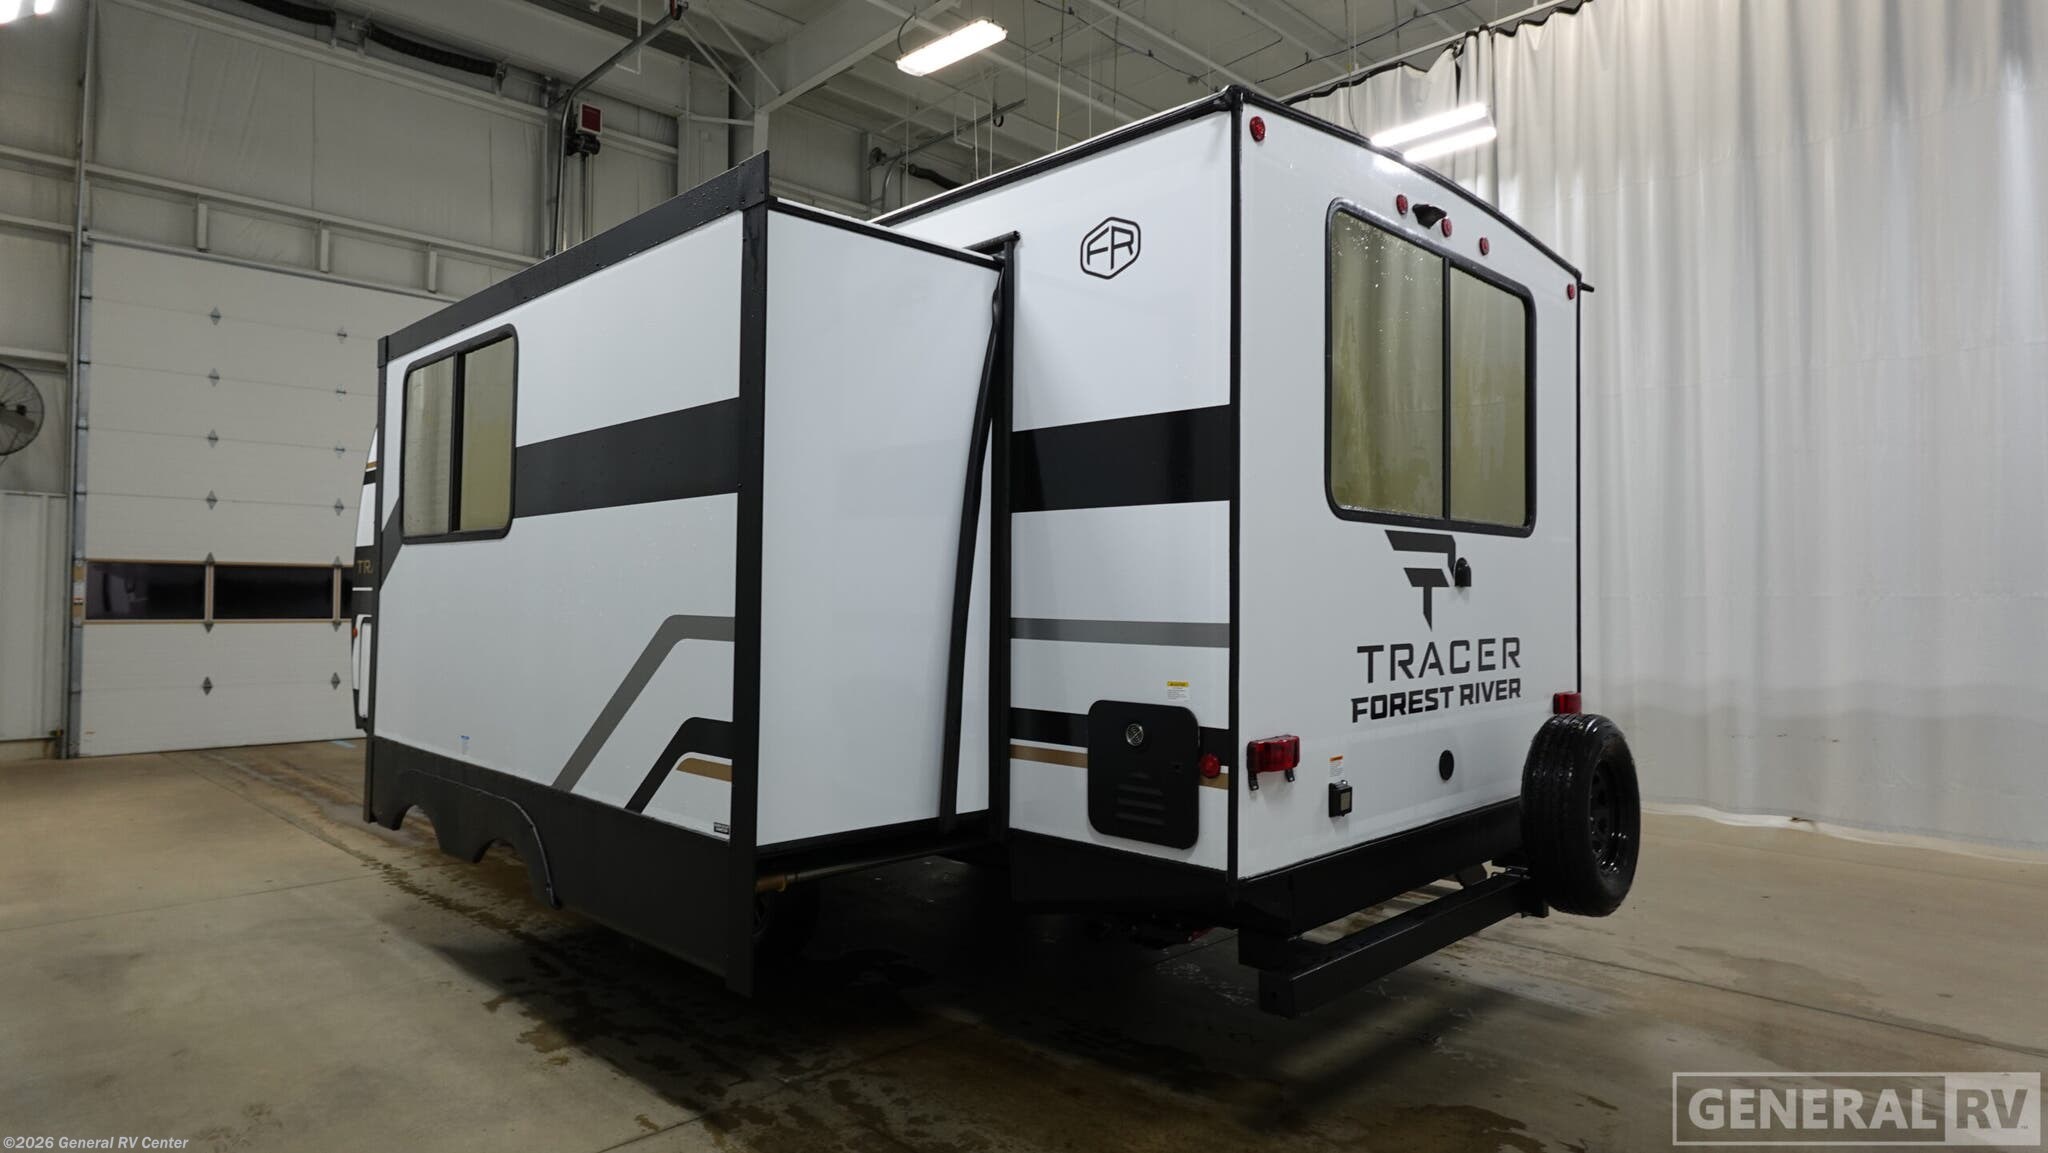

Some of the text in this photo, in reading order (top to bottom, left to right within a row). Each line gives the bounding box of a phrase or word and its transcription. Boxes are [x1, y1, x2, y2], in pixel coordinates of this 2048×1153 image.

[356, 559, 374, 576] TR
[1356, 636, 1521, 684] TRACER
[1351, 677, 1521, 723] FOREST RIVER
